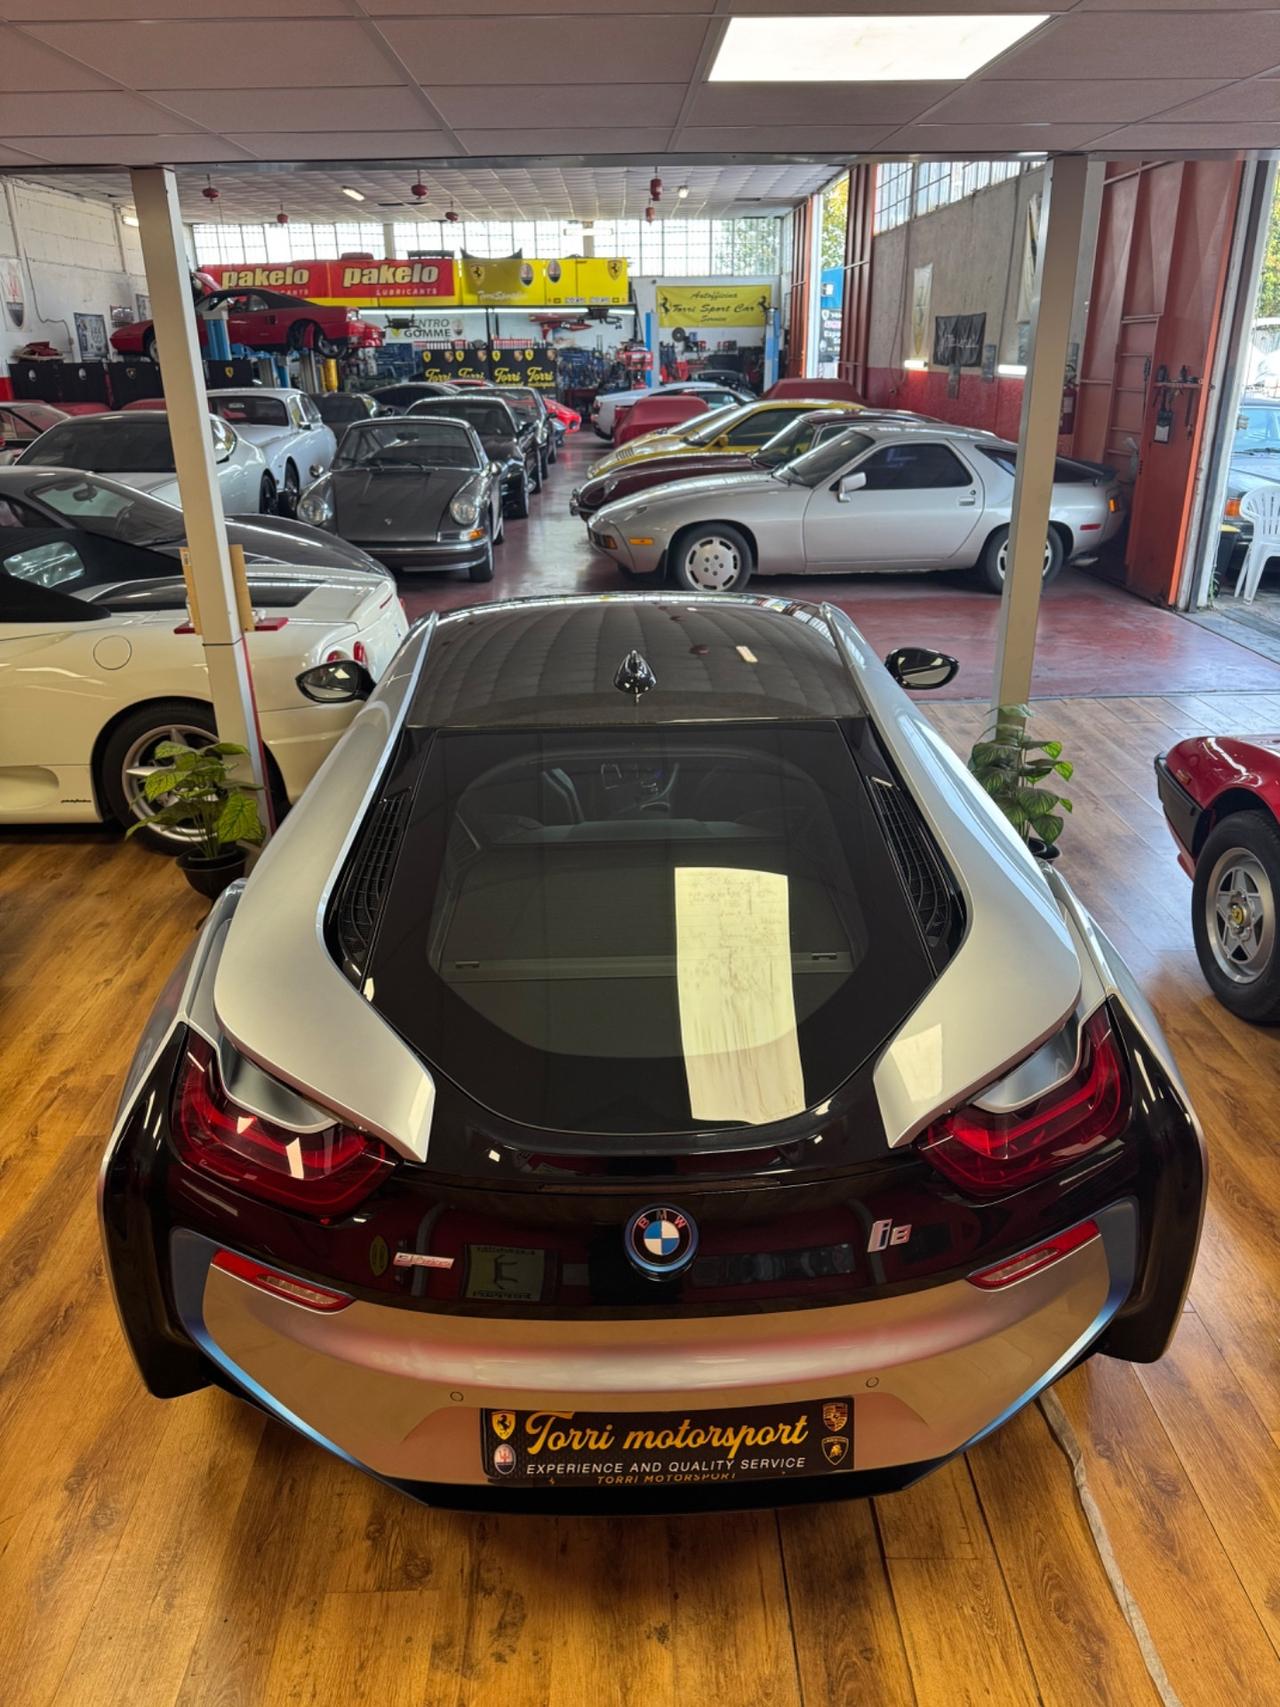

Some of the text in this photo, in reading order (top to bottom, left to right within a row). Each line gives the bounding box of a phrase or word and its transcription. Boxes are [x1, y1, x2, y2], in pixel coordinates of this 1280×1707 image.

[221, 265, 310, 288] pakelo
[342, 263, 439, 287] pakelo
[376, 287, 438, 296] LUBRICANTS
[672, 303, 755, 314] Torri Sport Car
[404, 328, 452, 338] GOMME
[494, 367, 521, 384] Torri
[527, 366, 554, 383] Torri
[637, 1208, 688, 1230] BMW
[867, 1218, 912, 1253] i8
[525, 1410, 810, 1459] Torri motorsport
[526, 1456, 807, 1475] EXPERIENCE AND QUALITY SERVICE
[597, 1474, 639, 1485] TORRI
